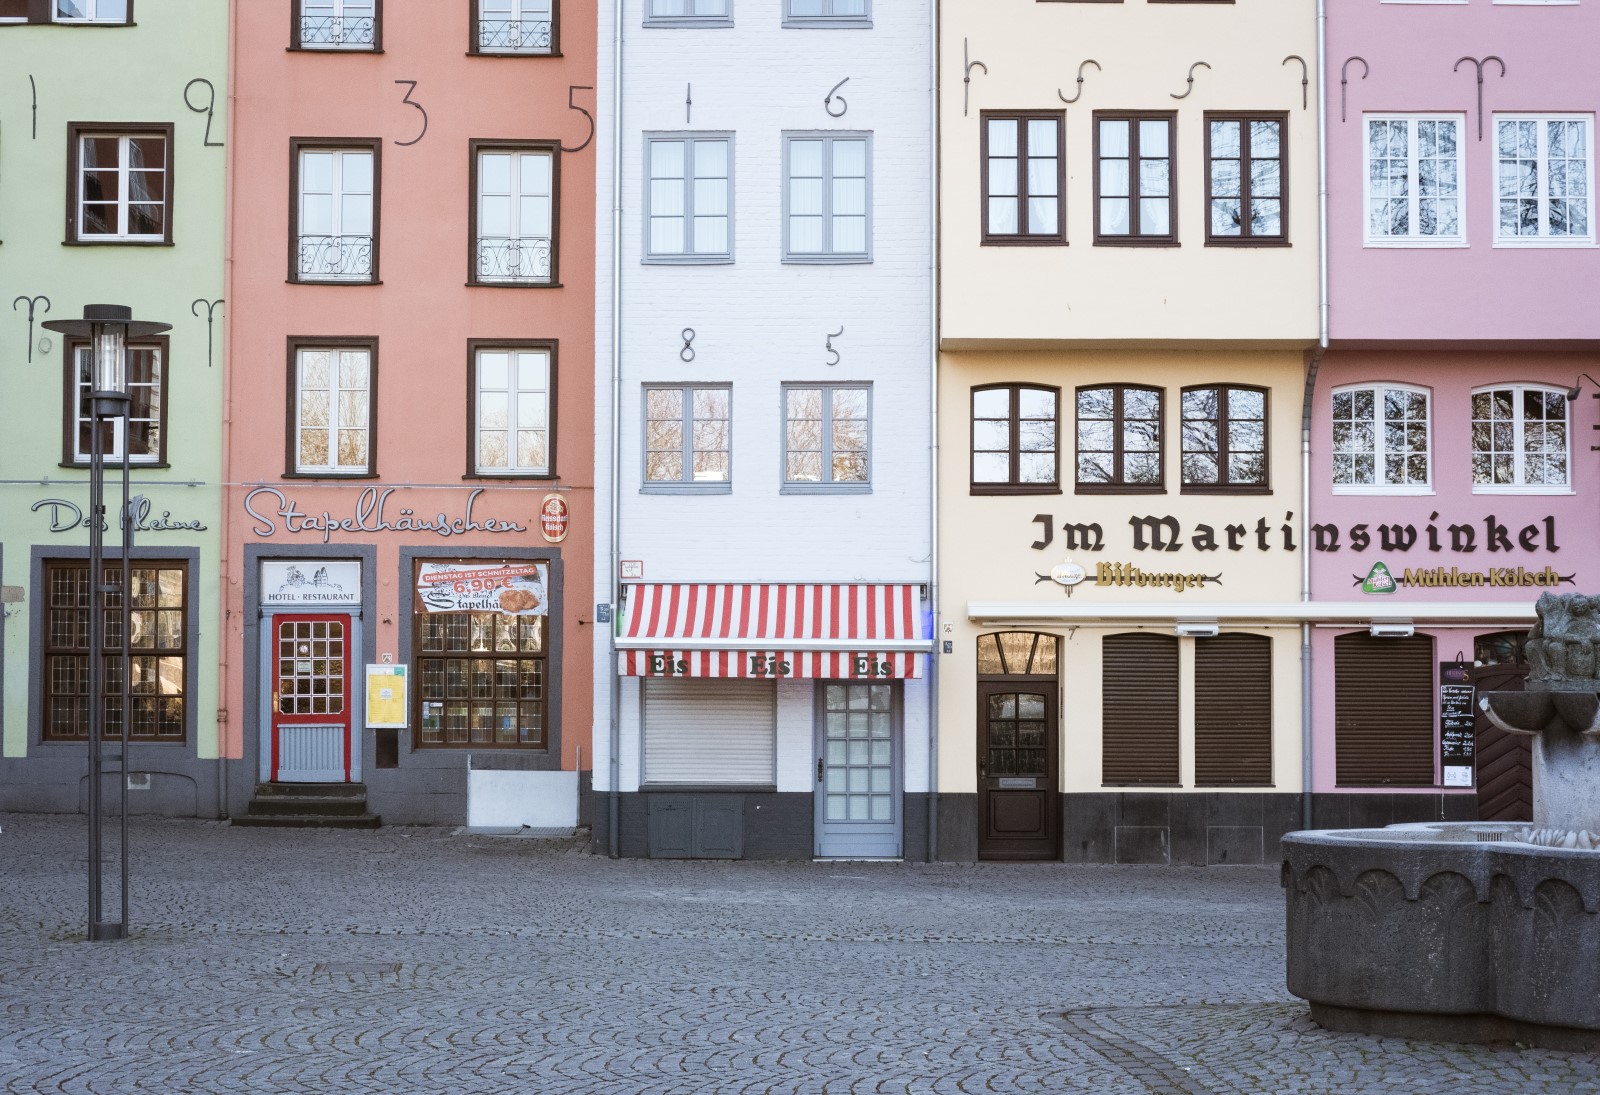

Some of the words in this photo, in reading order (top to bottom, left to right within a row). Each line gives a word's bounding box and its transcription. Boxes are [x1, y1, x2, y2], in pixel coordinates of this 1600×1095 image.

[824, 76, 850, 118] 6
[394, 79, 428, 147] 3
[559, 85, 595, 153] 5
[679, 327, 696, 363] 8
[825, 325, 844, 366] 5
[119, 497, 208, 532] leine
[244, 486, 527, 543] Stapelhäuschen
[1030, 513, 1105, 552] Im
[1128, 510, 1561, 553] Martinswinkel
[425, 573, 463, 581] DIENSTAG
[477, 567, 535, 577] SCHNITZELTAG
[453, 578, 496, 593] 6,90
[501, 576, 514, 589] €
[1094, 561, 1207, 593] Bitburger
[1402, 567, 1484, 588] Mühlen
[1489, 566, 1560, 587] Kölsch
[268, 593, 296, 601] HOTEL
[302, 592, 355, 601] RESTAURANT
[424, 590, 502, 609] Stapelhä
[649, 655, 689, 674] Eis
[749, 655, 791, 675] Eis
[852, 656, 894, 676] Eis
